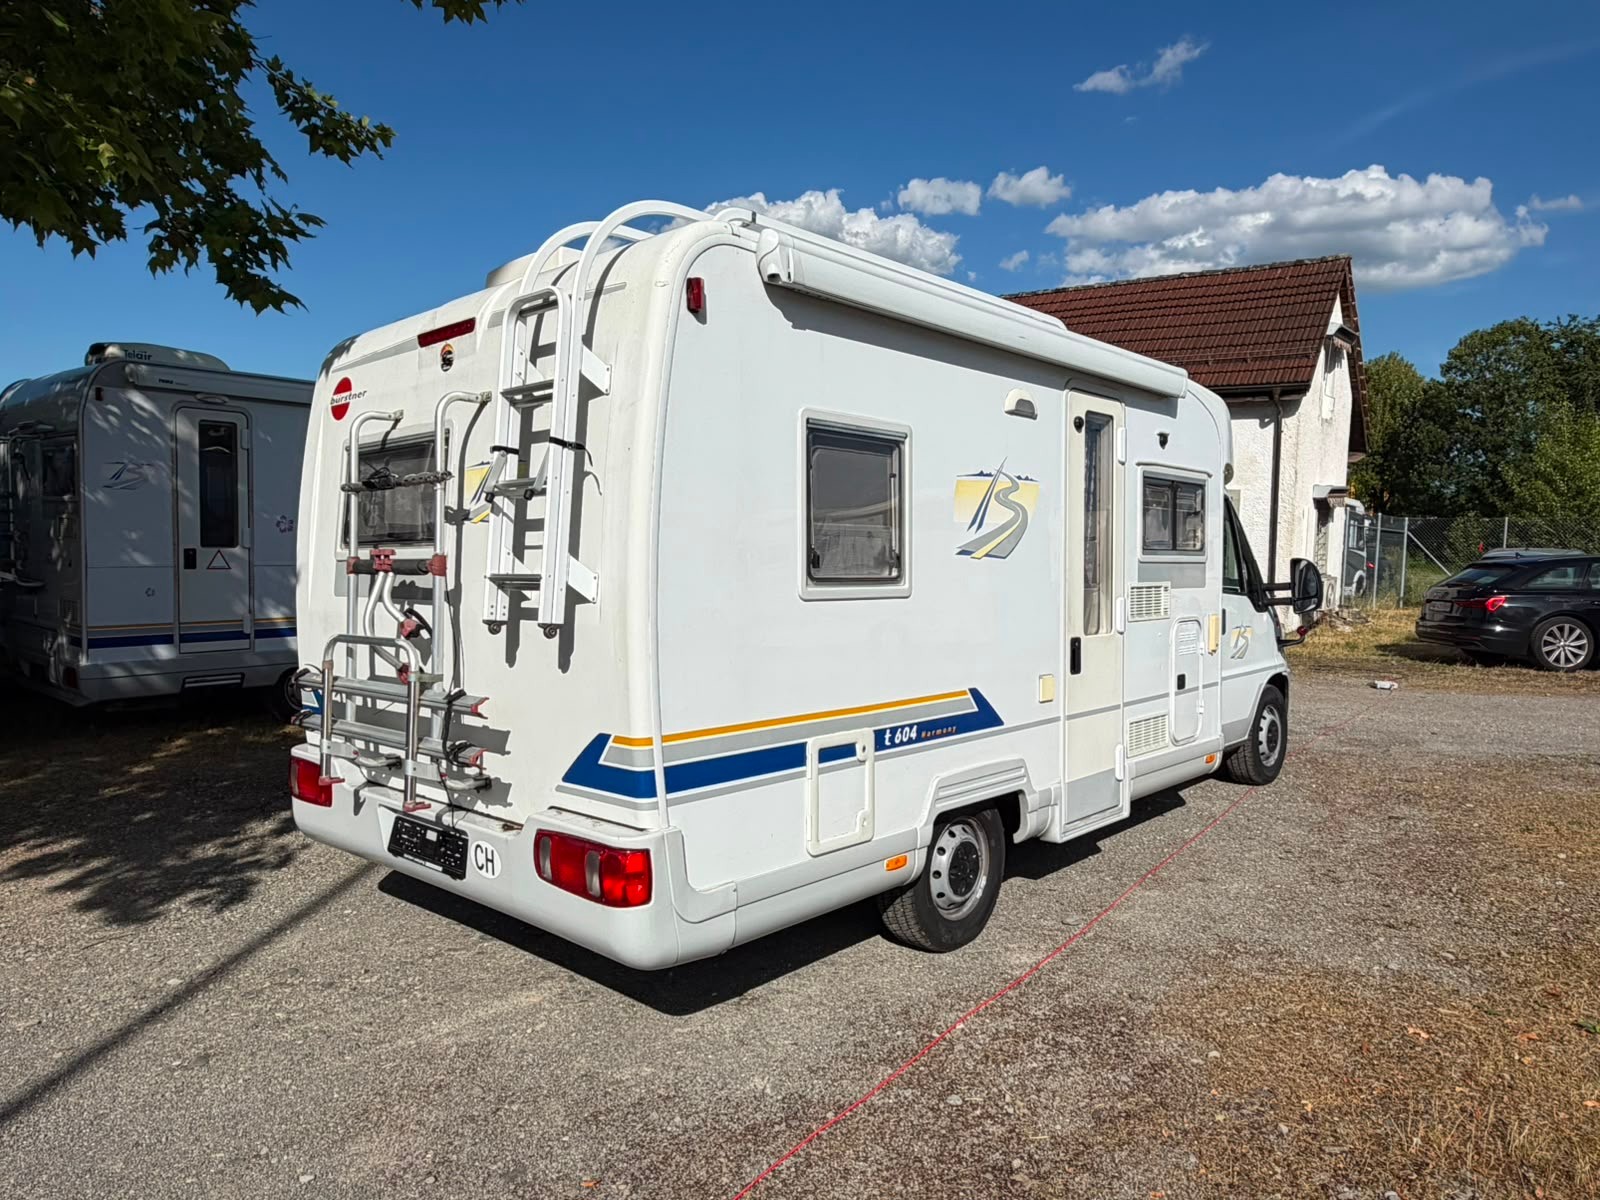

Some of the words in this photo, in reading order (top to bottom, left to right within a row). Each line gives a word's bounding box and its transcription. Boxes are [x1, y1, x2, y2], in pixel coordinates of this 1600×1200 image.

[123, 349, 153, 361] Telair
[330, 390, 368, 405] bürstner
[894, 725, 918, 744] 604
[921, 725, 957, 738] Harmony
[474, 844, 495, 876] CH
